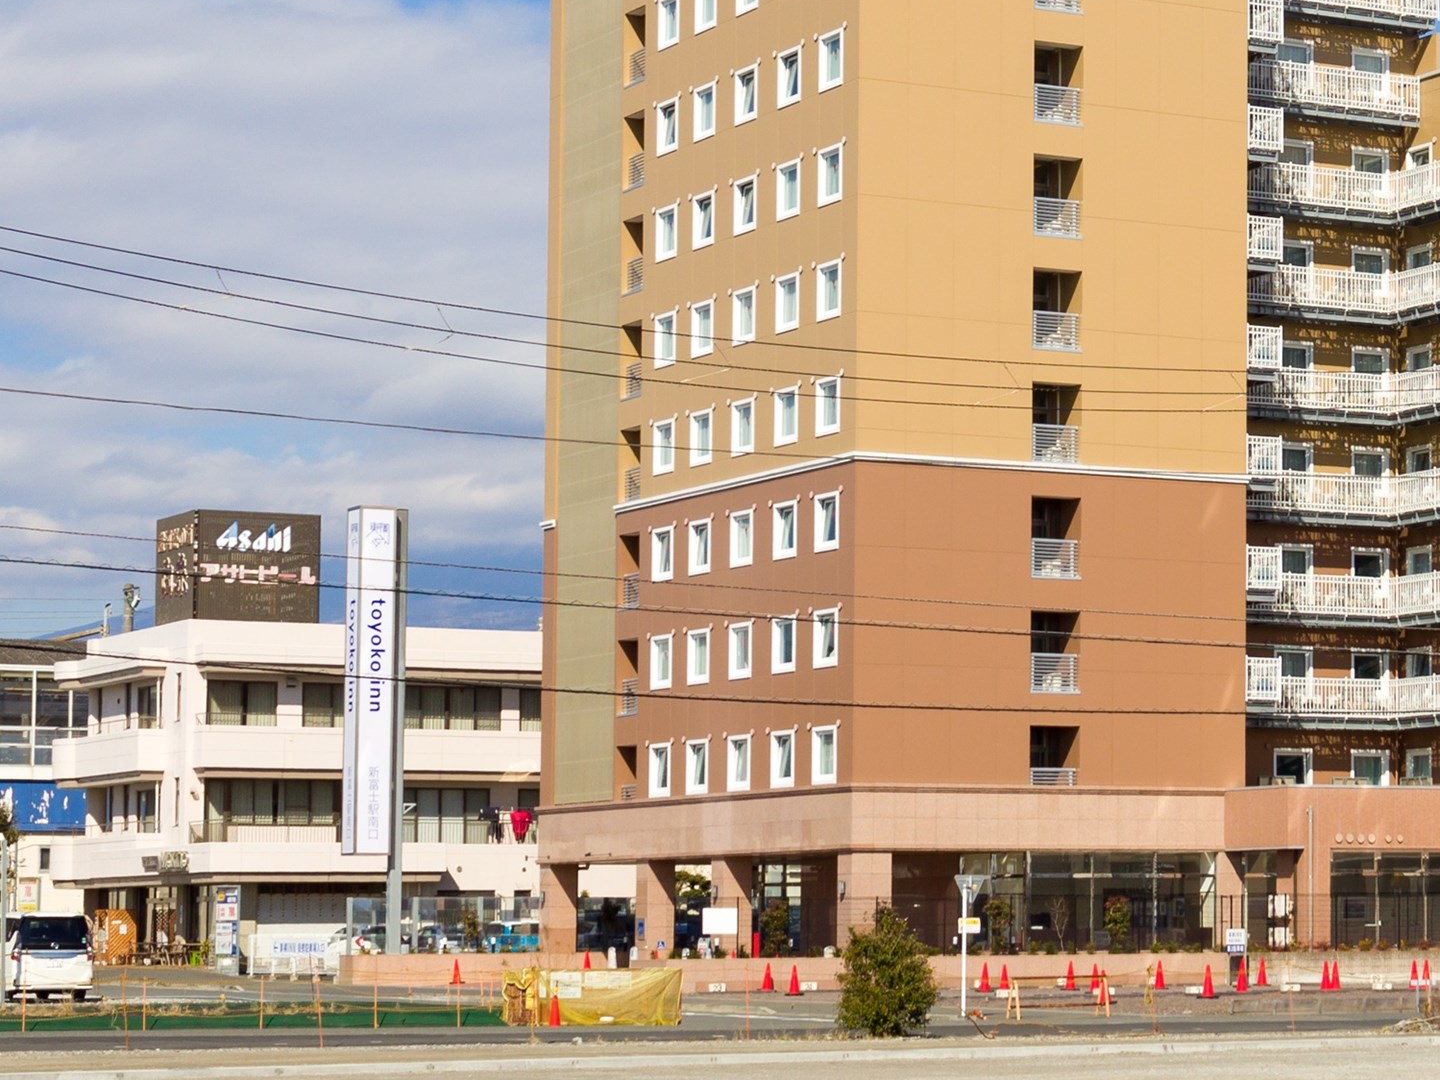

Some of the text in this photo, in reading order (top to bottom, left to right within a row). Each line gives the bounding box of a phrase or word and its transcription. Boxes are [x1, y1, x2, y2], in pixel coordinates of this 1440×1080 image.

[216, 520, 292, 553] Asahi
[200, 563, 317, 585] アサヒビール
[368, 599, 386, 712] toyoko inn
